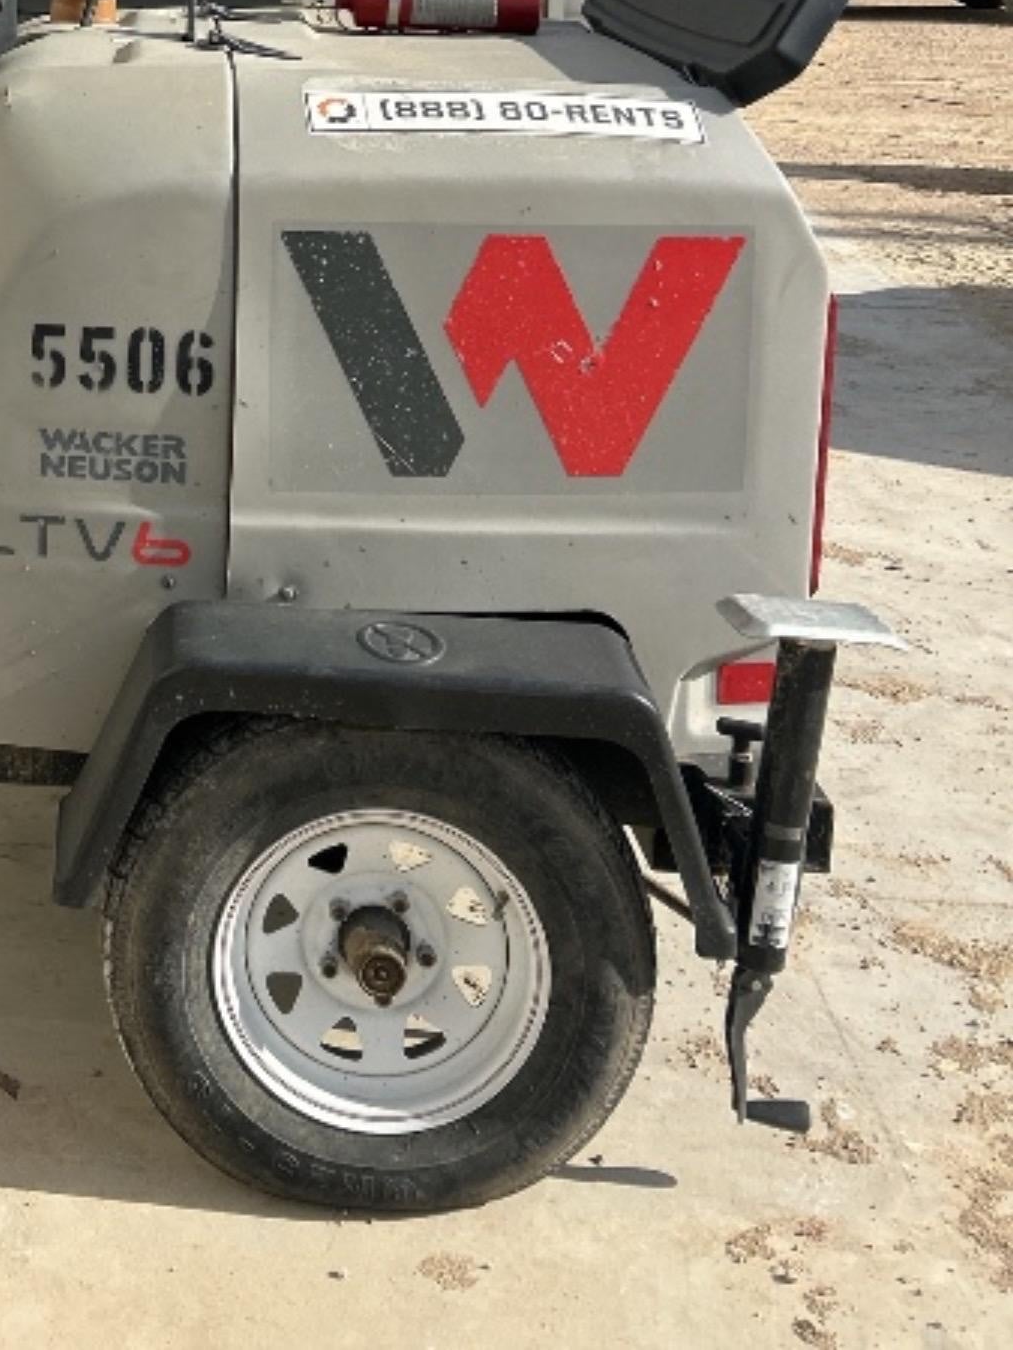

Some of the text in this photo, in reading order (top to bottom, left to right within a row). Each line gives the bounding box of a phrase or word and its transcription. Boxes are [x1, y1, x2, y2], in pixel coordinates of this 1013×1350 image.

[378, 98, 685, 130] (888) 80-RENTS
[30, 323, 215, 397] 5506
[39, 427, 188, 460] WACKER
[40, 452, 188, 485] NEUSON
